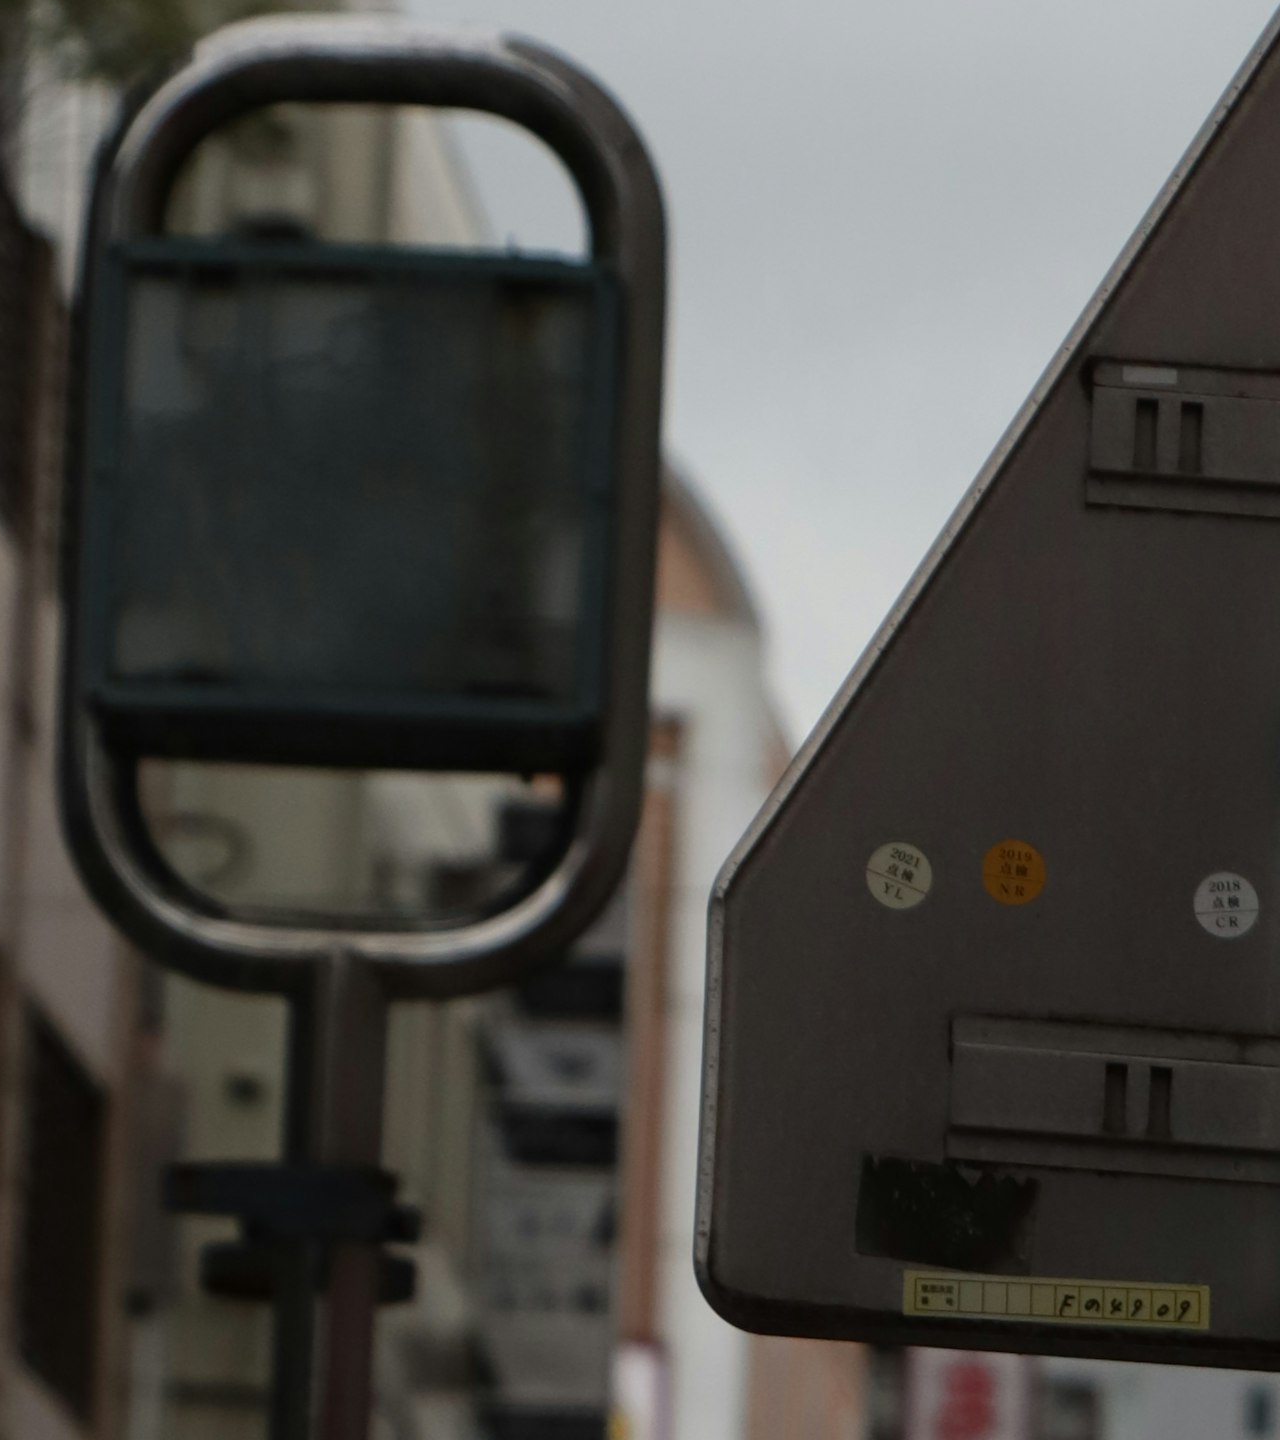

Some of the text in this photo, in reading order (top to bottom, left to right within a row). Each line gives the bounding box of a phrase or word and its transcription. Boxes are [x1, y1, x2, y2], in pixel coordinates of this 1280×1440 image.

[890, 847, 920, 868] 2021
[999, 848, 1033, 863] 2019
[885, 863, 915, 883] 点検
[1000, 862, 1028, 878] 点検
[1208, 879, 1241, 893] 2018
[1213, 895, 1240, 909] 点検
